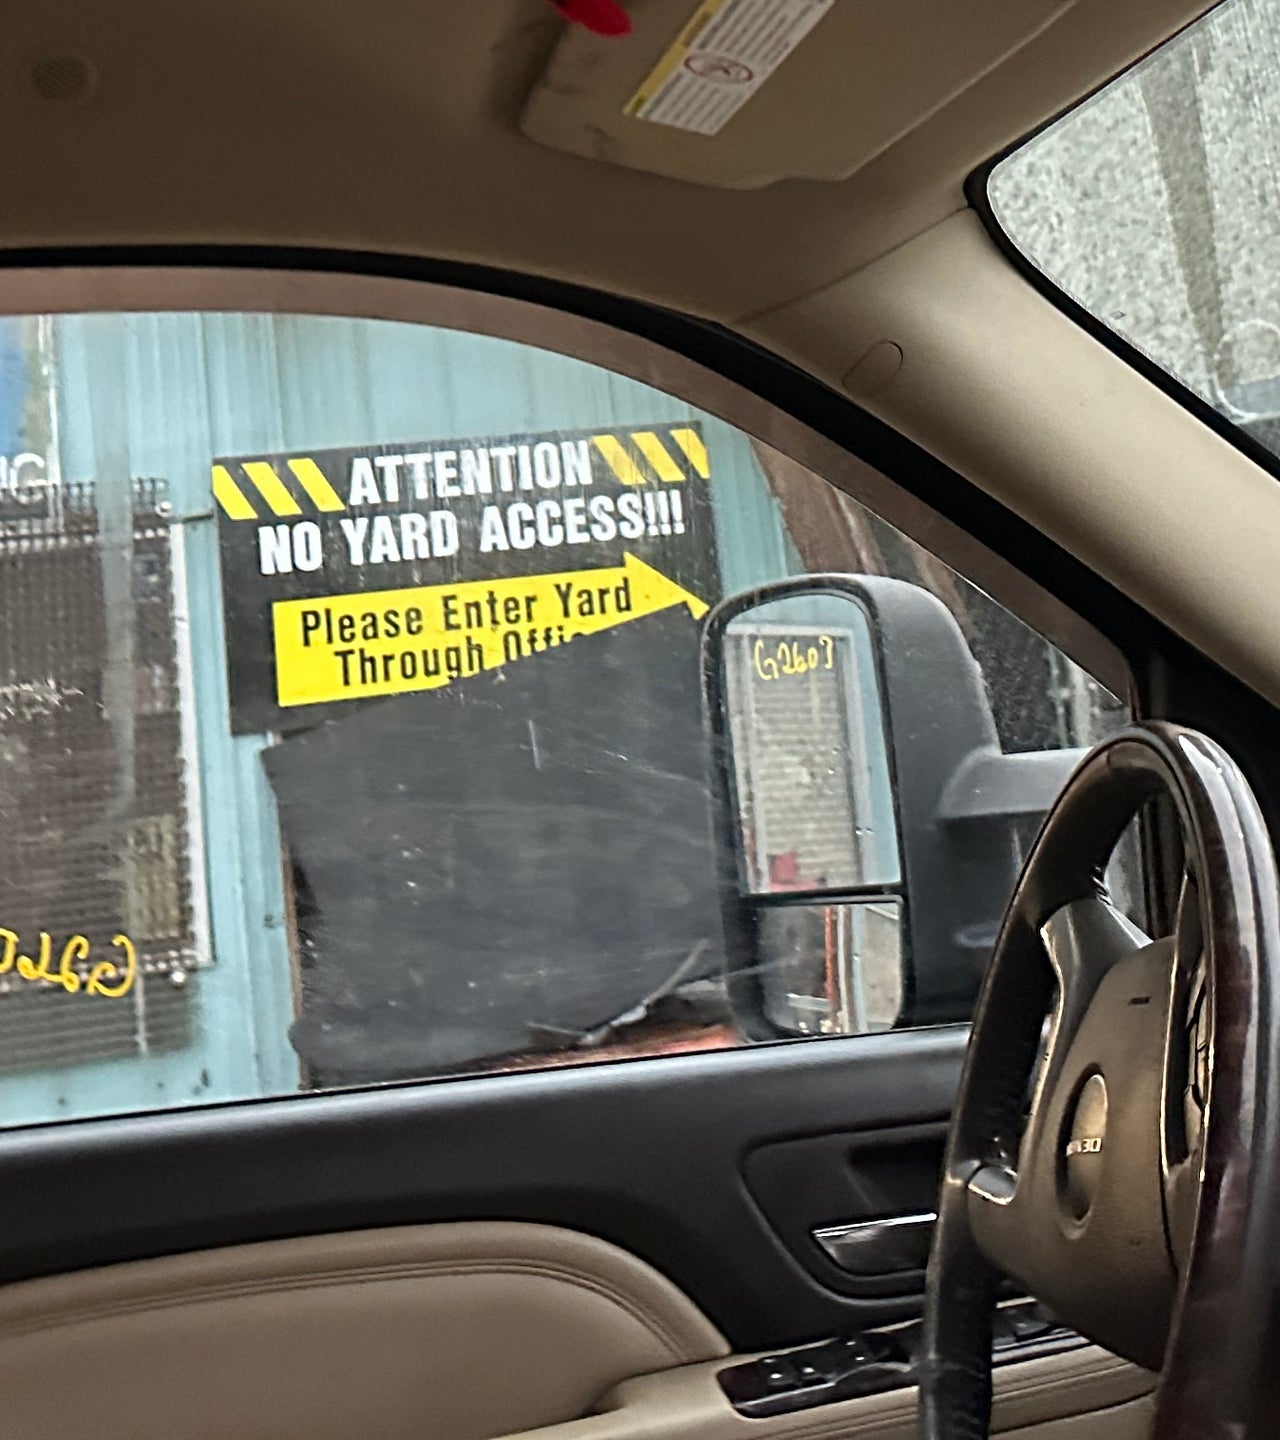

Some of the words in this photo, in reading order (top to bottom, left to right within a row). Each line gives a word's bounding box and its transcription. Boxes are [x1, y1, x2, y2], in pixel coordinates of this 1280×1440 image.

[349, 440, 593, 506] ATTENTION
[258, 521, 323, 575] NO
[340, 510, 460, 566] YARD
[480, 489, 685, 553] ACCESS!!!
[301, 606, 423, 647] Please
[442, 590, 537, 632] Enter
[554, 577, 632, 619] Yard
[334, 635, 485, 687] Through
